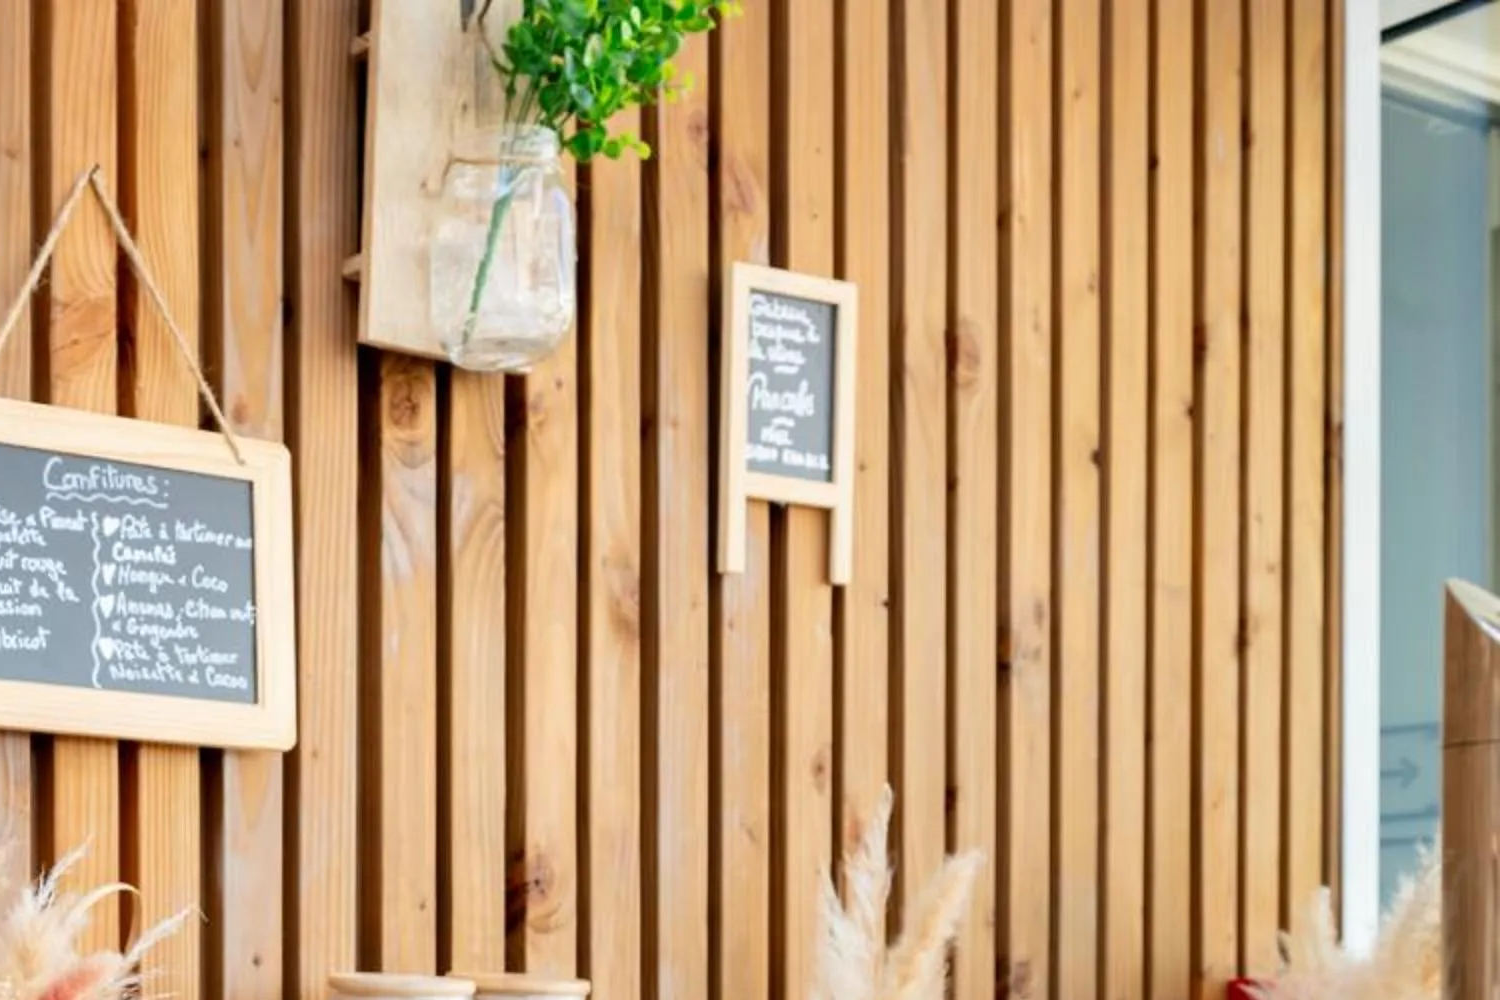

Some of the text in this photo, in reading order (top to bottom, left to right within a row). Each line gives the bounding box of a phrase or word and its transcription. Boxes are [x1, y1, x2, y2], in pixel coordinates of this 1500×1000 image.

[21, 557, 68, 582] rouge
[29, 576, 50, 598] de
[57, 580, 81, 603] la
